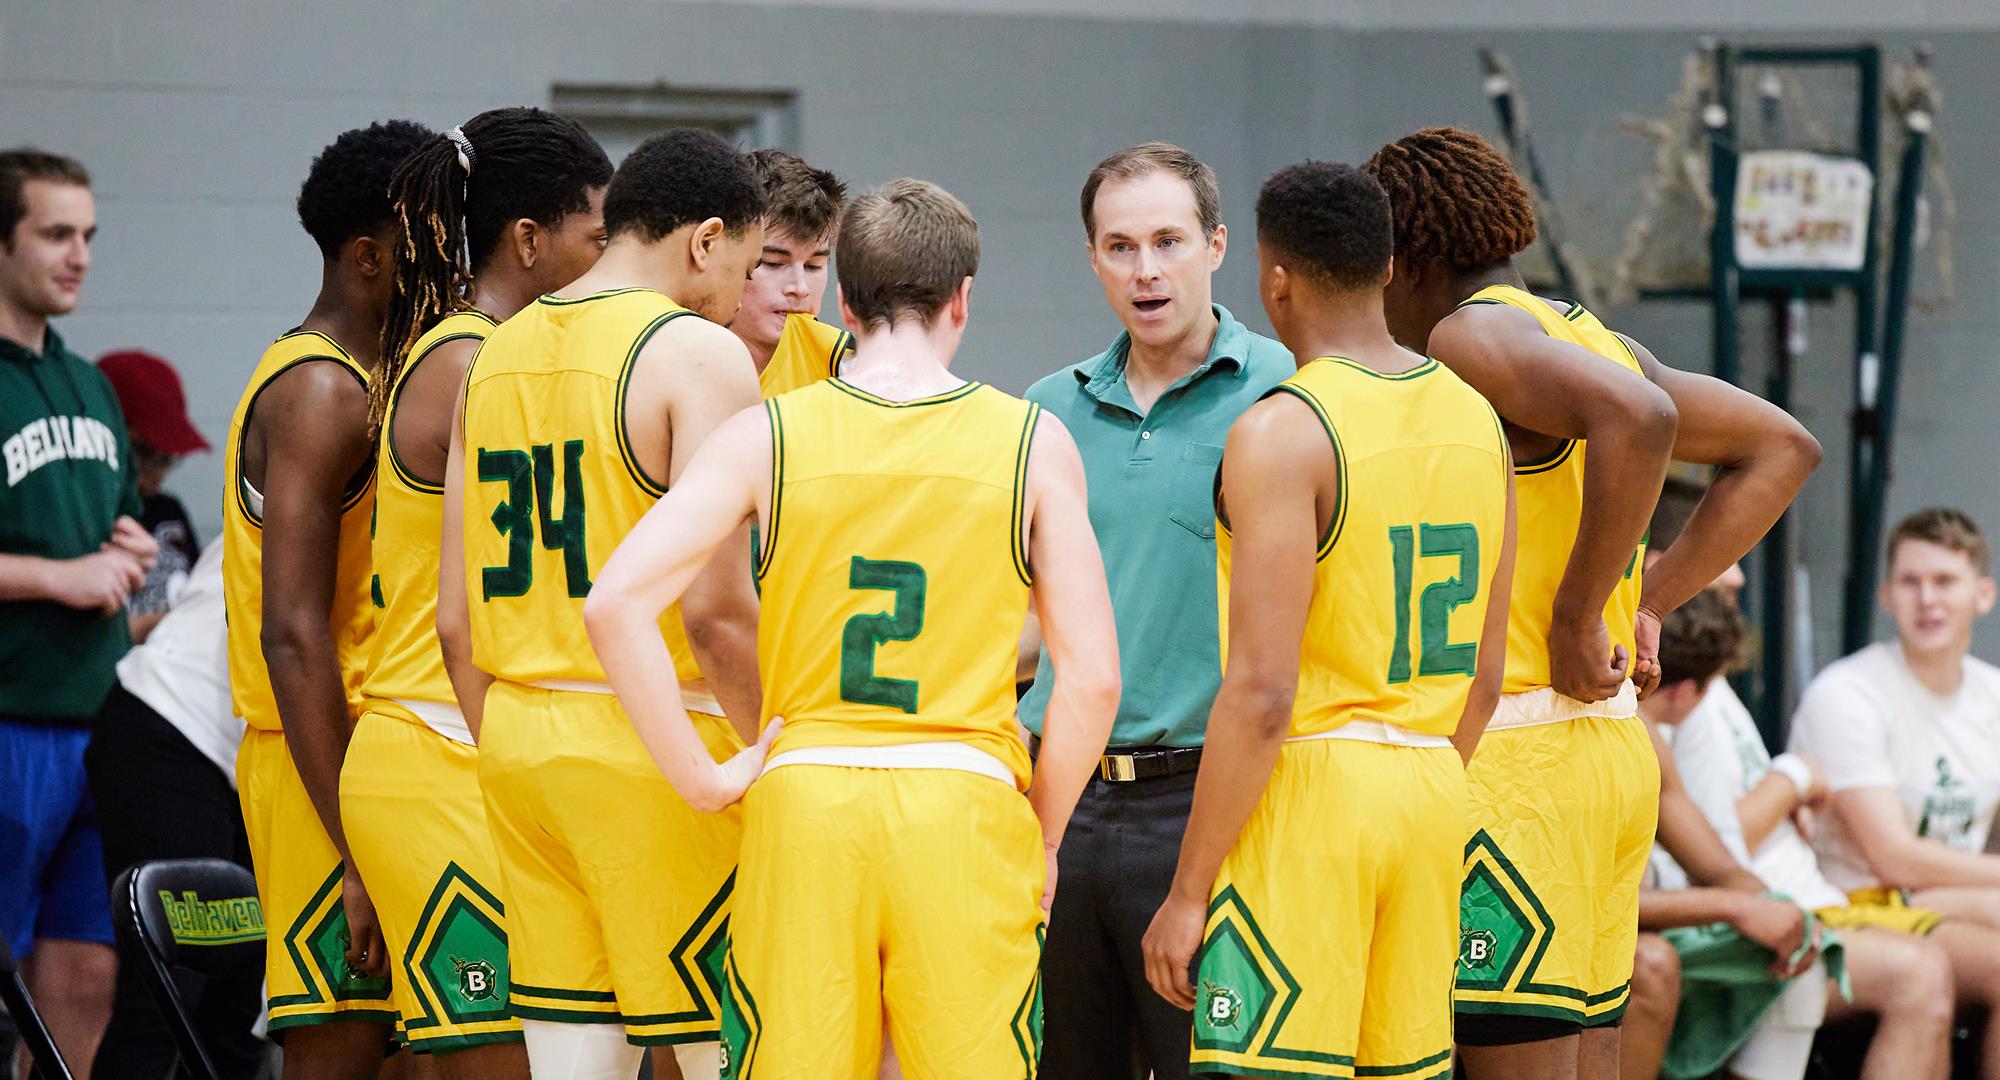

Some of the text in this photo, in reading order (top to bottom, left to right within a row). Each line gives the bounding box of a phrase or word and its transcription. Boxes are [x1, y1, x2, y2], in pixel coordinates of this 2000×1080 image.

[478, 439, 593, 602] 34
[1387, 522, 1480, 684] 12
[840, 555, 927, 715] 2
[158, 890, 266, 932] Belhaven
[1470, 938, 1487, 960] B
[467, 970, 487, 992] B
[1212, 996, 1232, 1019] B
